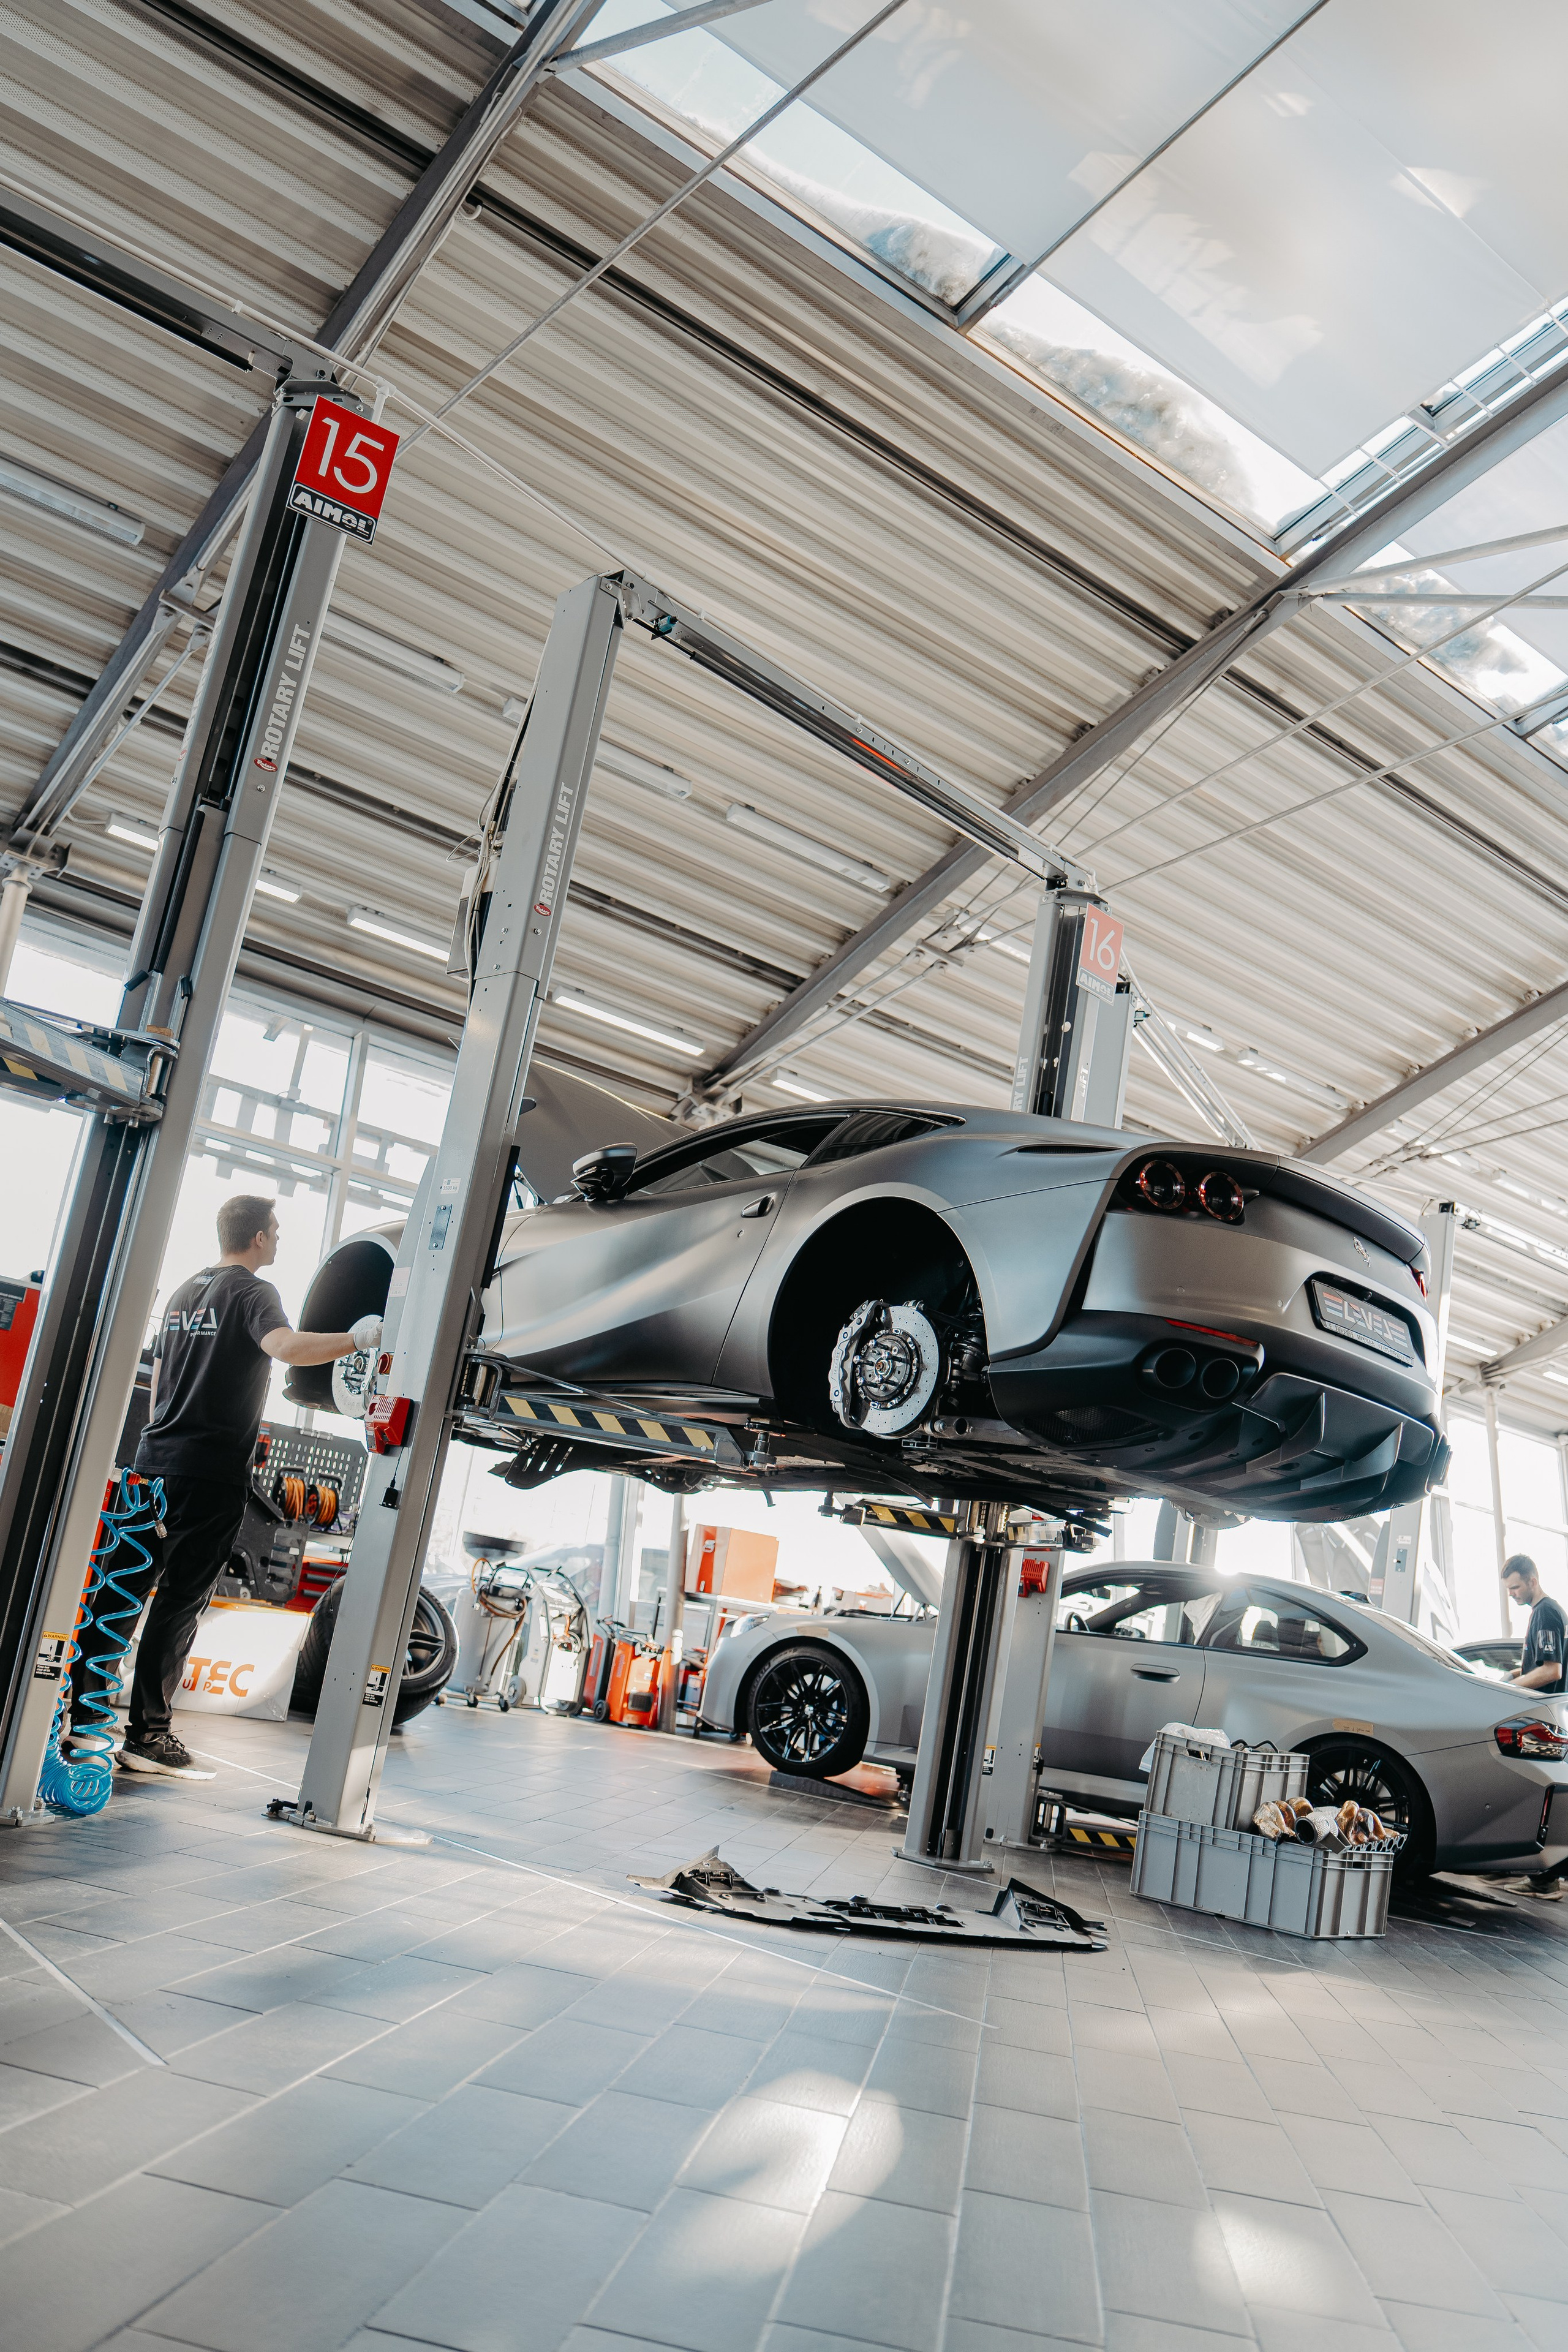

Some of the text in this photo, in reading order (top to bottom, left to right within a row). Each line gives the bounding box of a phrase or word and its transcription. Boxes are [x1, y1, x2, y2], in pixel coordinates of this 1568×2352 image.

[318, 417, 385, 494] 15
[260, 623, 311, 760] ROTARY LIFT
[538, 782, 573, 905] ROTARY LIFT
[1090, 918, 1115, 970] 16
[1016, 1057, 1028, 1087] LIFT
